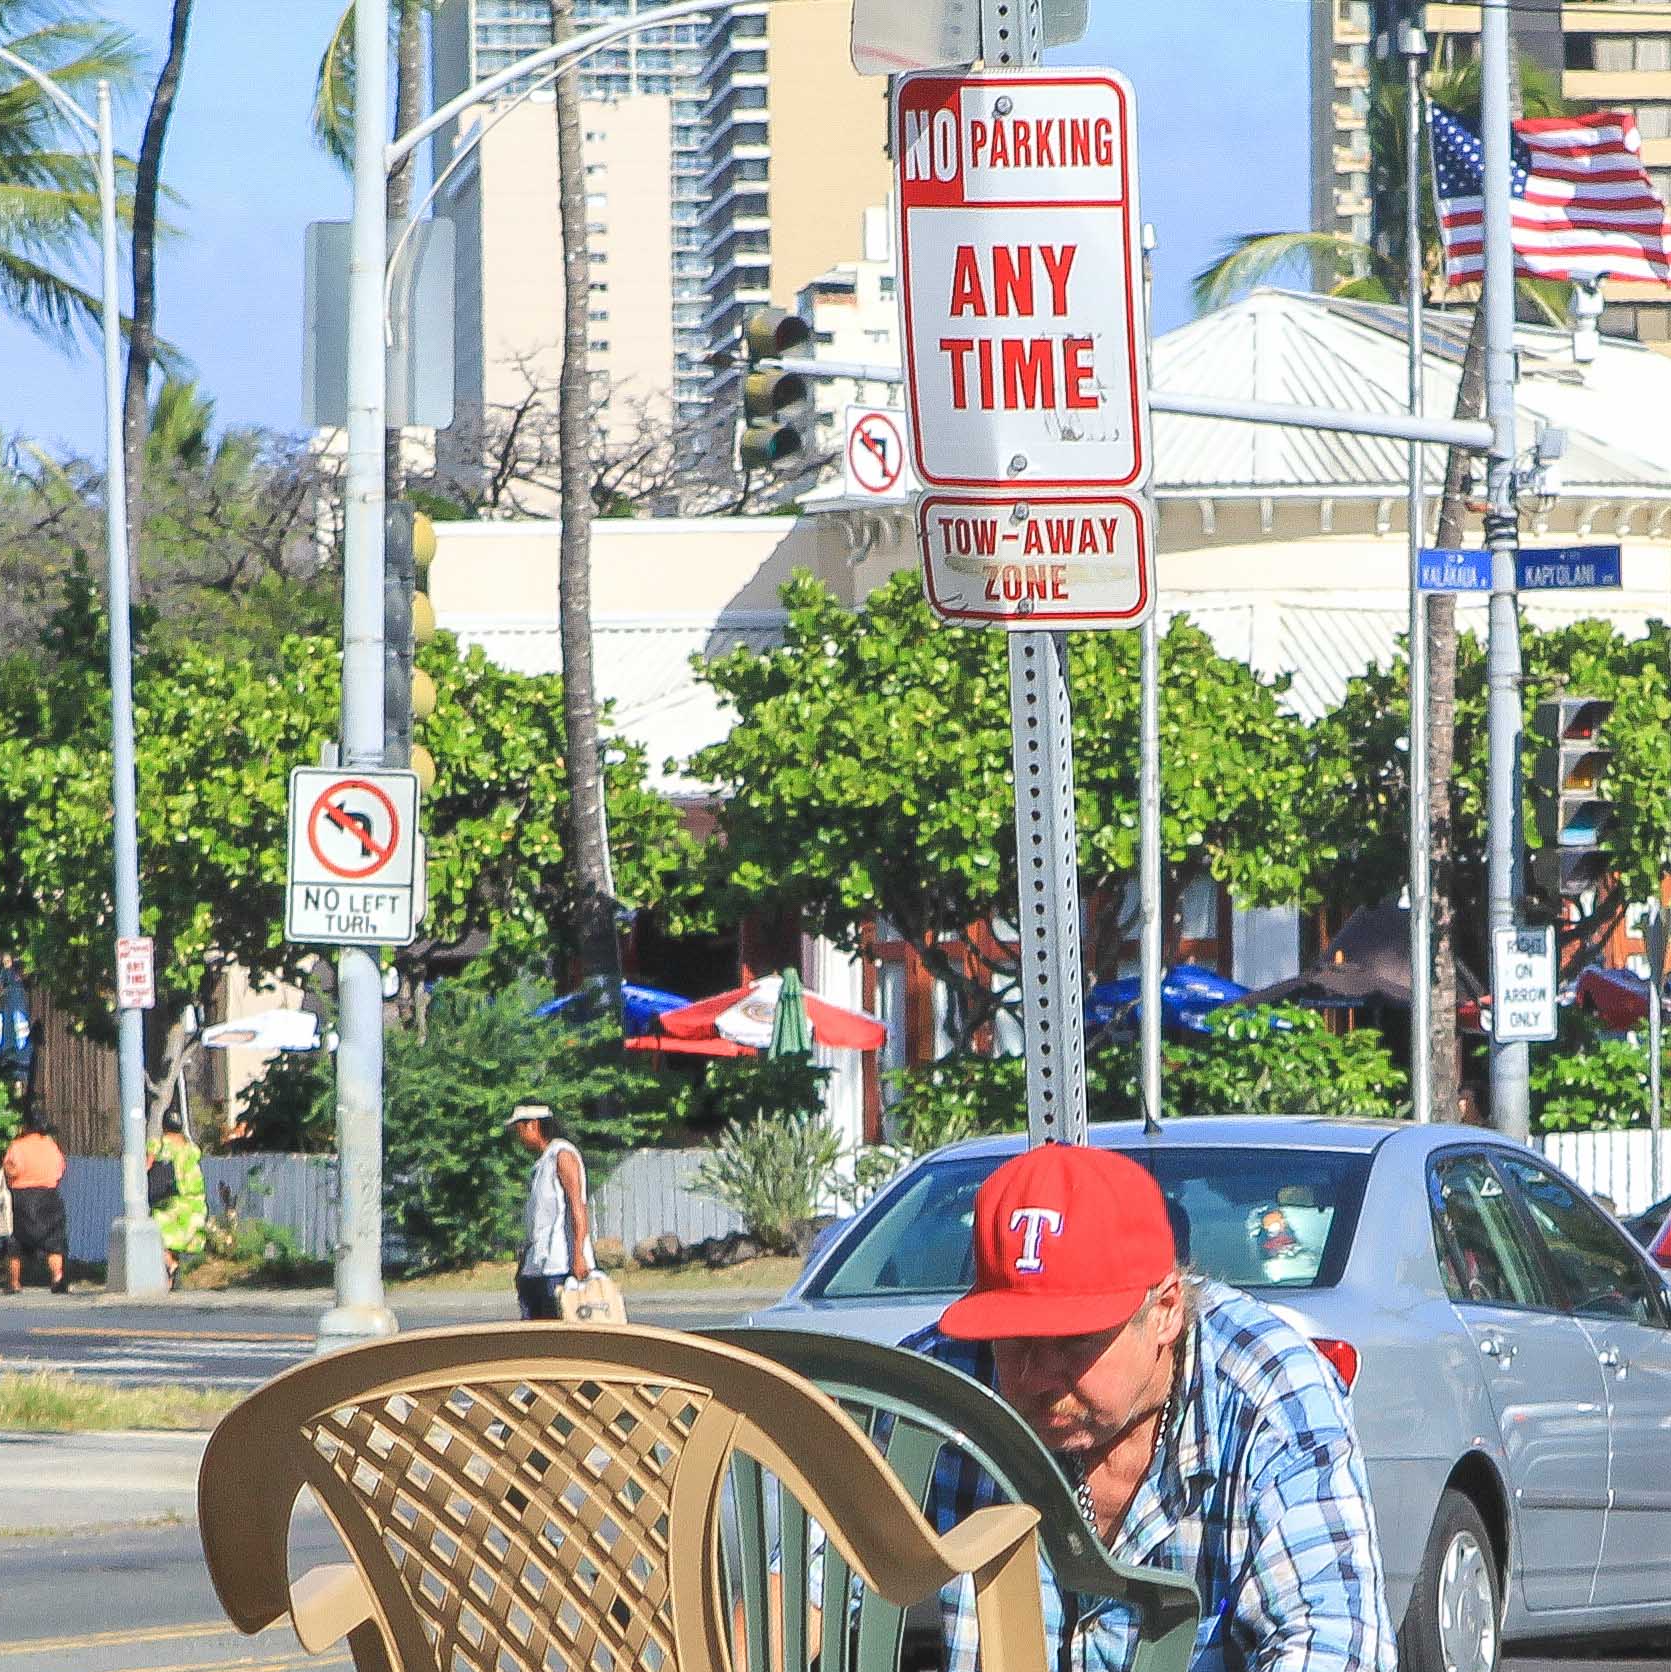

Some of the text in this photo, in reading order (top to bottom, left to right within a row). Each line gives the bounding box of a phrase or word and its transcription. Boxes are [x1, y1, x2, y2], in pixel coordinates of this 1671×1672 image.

[905, 108, 1114, 182] NO PARKING
[949, 244, 1078, 318] ANY
[939, 338, 1100, 410] TIME
[938, 517, 1119, 557] TOW-AWAY
[982, 564, 1070, 601] ZONE
[304, 888, 399, 914] NO LEFT
[1504, 988, 1546, 1002] ARROW
[1008, 1206, 1065, 1275] T
